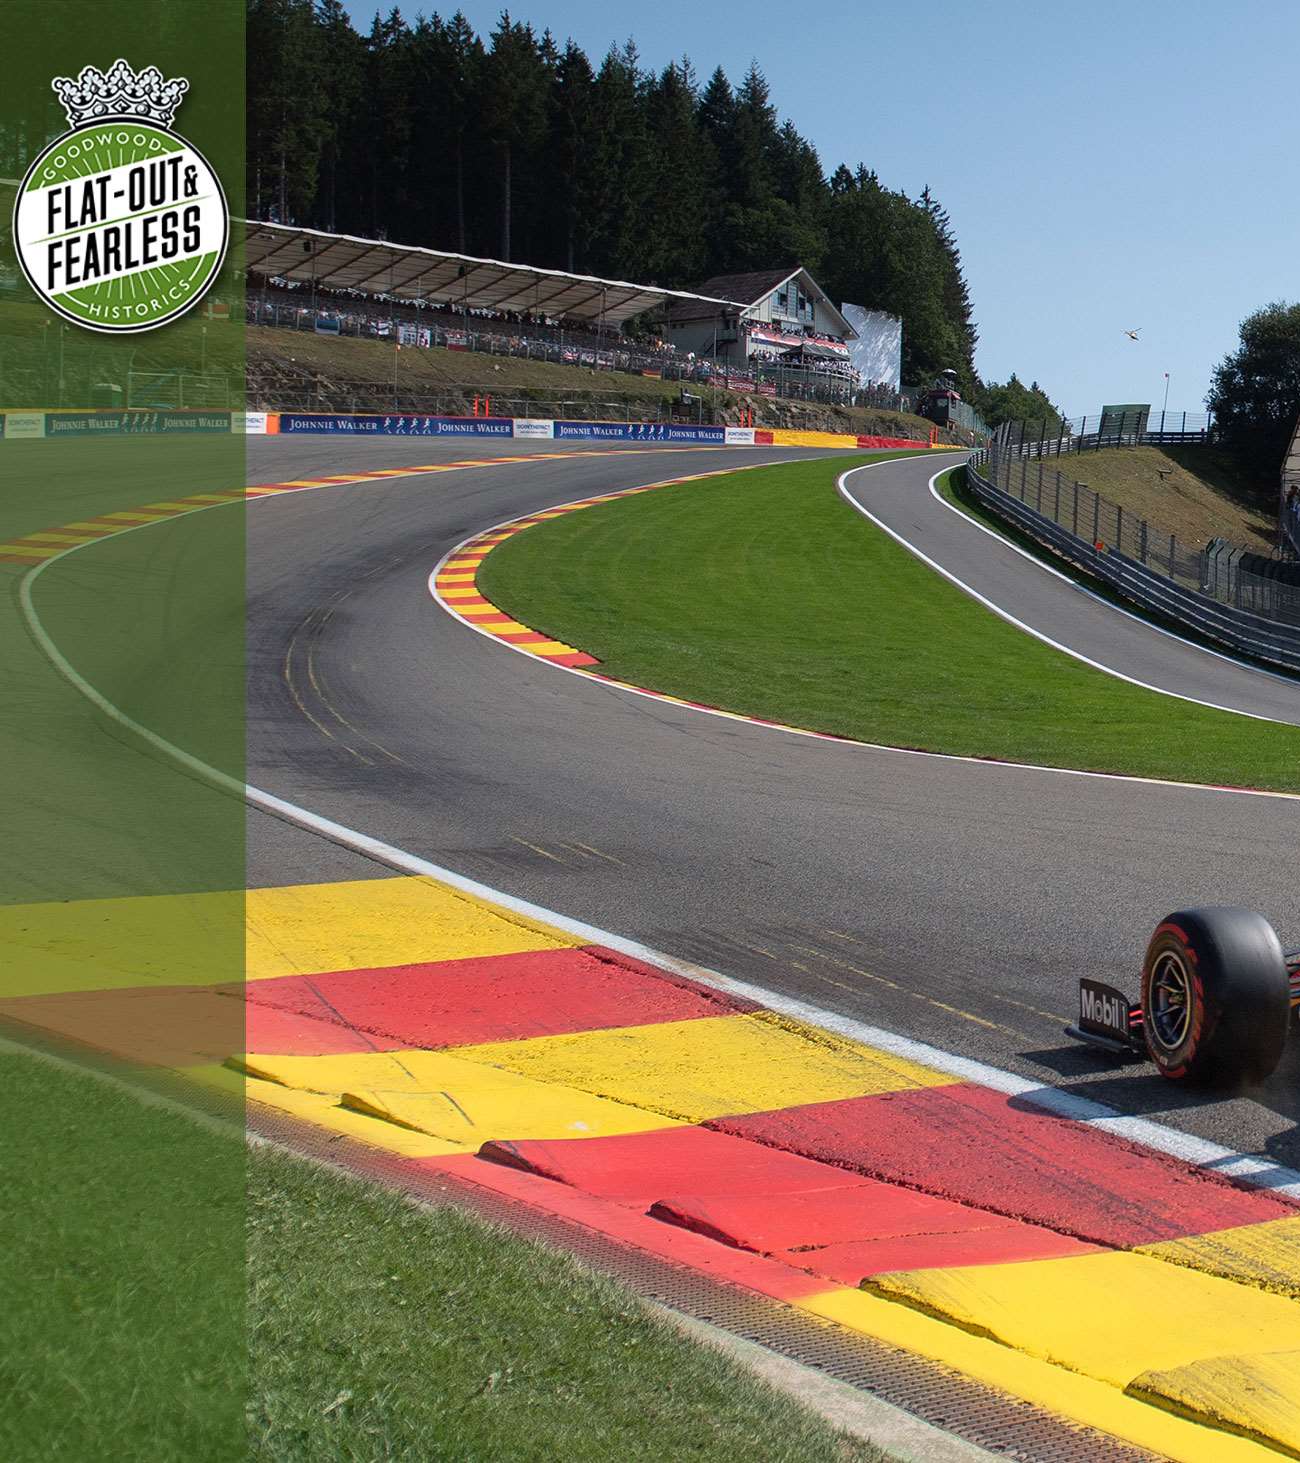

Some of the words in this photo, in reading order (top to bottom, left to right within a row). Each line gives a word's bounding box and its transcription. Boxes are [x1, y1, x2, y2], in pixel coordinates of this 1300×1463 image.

[289, 419, 334, 431] JOHNNIE
[337, 420, 377, 430] WALKER
[438, 422, 474, 433] JOHNNIE
[476, 424, 510, 433] WALKER
[560, 425, 591, 436] JOHNNIE
[593, 427, 623, 436] WALKER
[668, 429, 696, 439] JOHNNIE
[698, 431, 724, 440] WALKER
[1081, 988, 1120, 1028] Mobil
